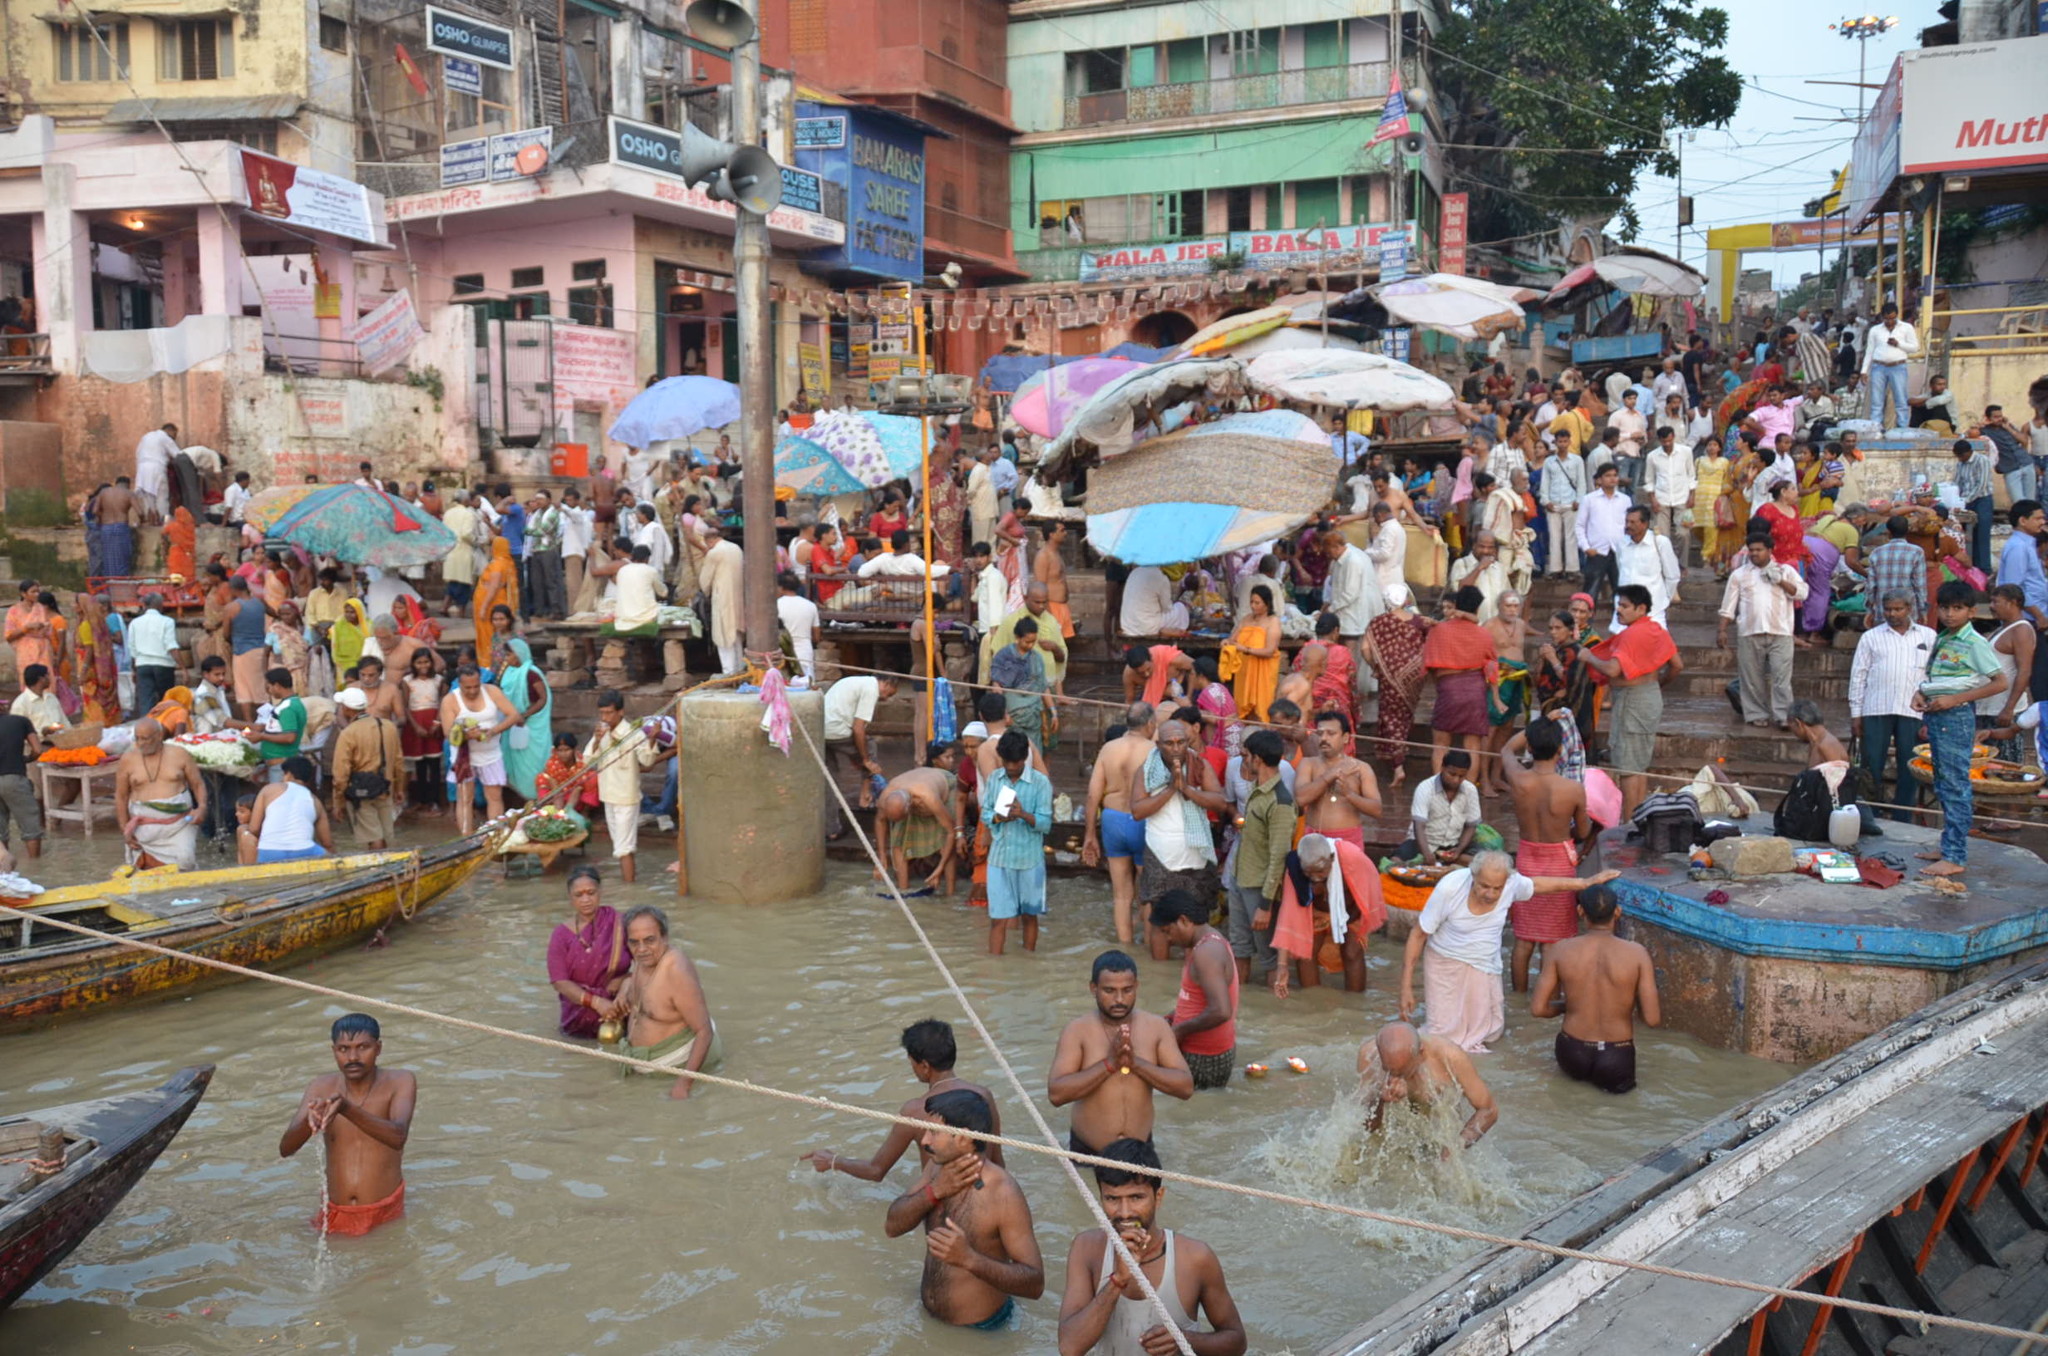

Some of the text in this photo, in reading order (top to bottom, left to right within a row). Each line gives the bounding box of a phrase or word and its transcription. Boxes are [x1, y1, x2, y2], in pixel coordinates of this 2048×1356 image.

[435, 23, 509, 55] OSHO GLIMPSE
[621, 133, 668, 162] OSHO
[854, 134, 922, 184] BANARAS
[781, 169, 818, 191] OUSE
[1253, 231, 1342, 254] BALA
[1444, 228, 1463, 242] Silk
[1097, 247, 1167, 268] BALA
[1176, 242, 1224, 261] JEE
